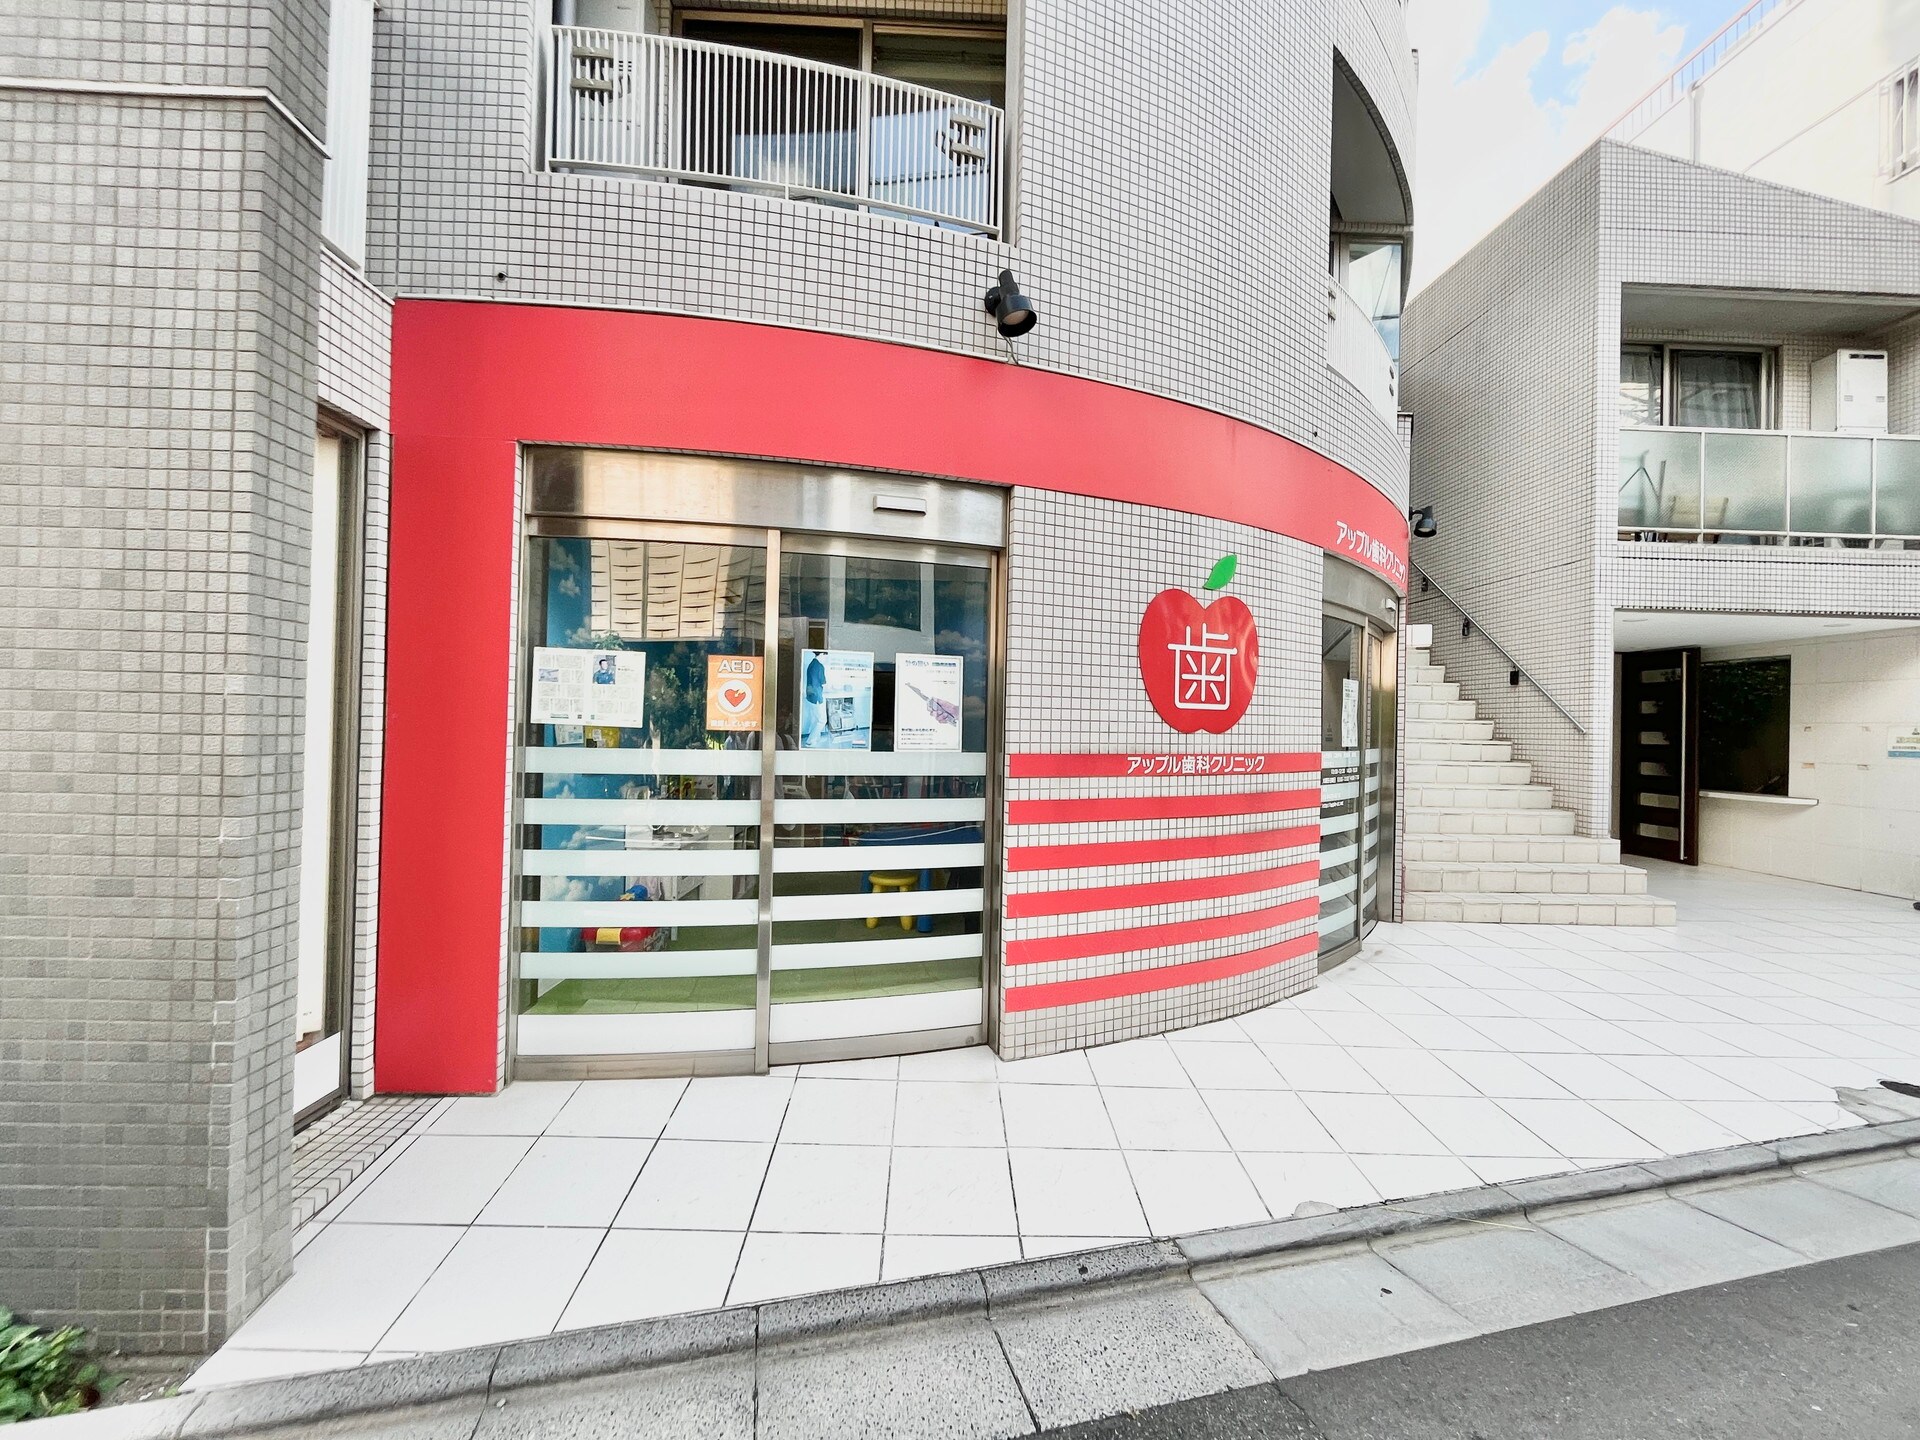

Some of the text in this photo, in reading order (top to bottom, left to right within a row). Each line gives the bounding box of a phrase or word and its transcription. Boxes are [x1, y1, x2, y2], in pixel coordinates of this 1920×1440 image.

[718, 659, 755, 674] AED
[1167, 623, 1238, 710] 歯
[1127, 755, 1265, 774] アップル歯科クリニック
